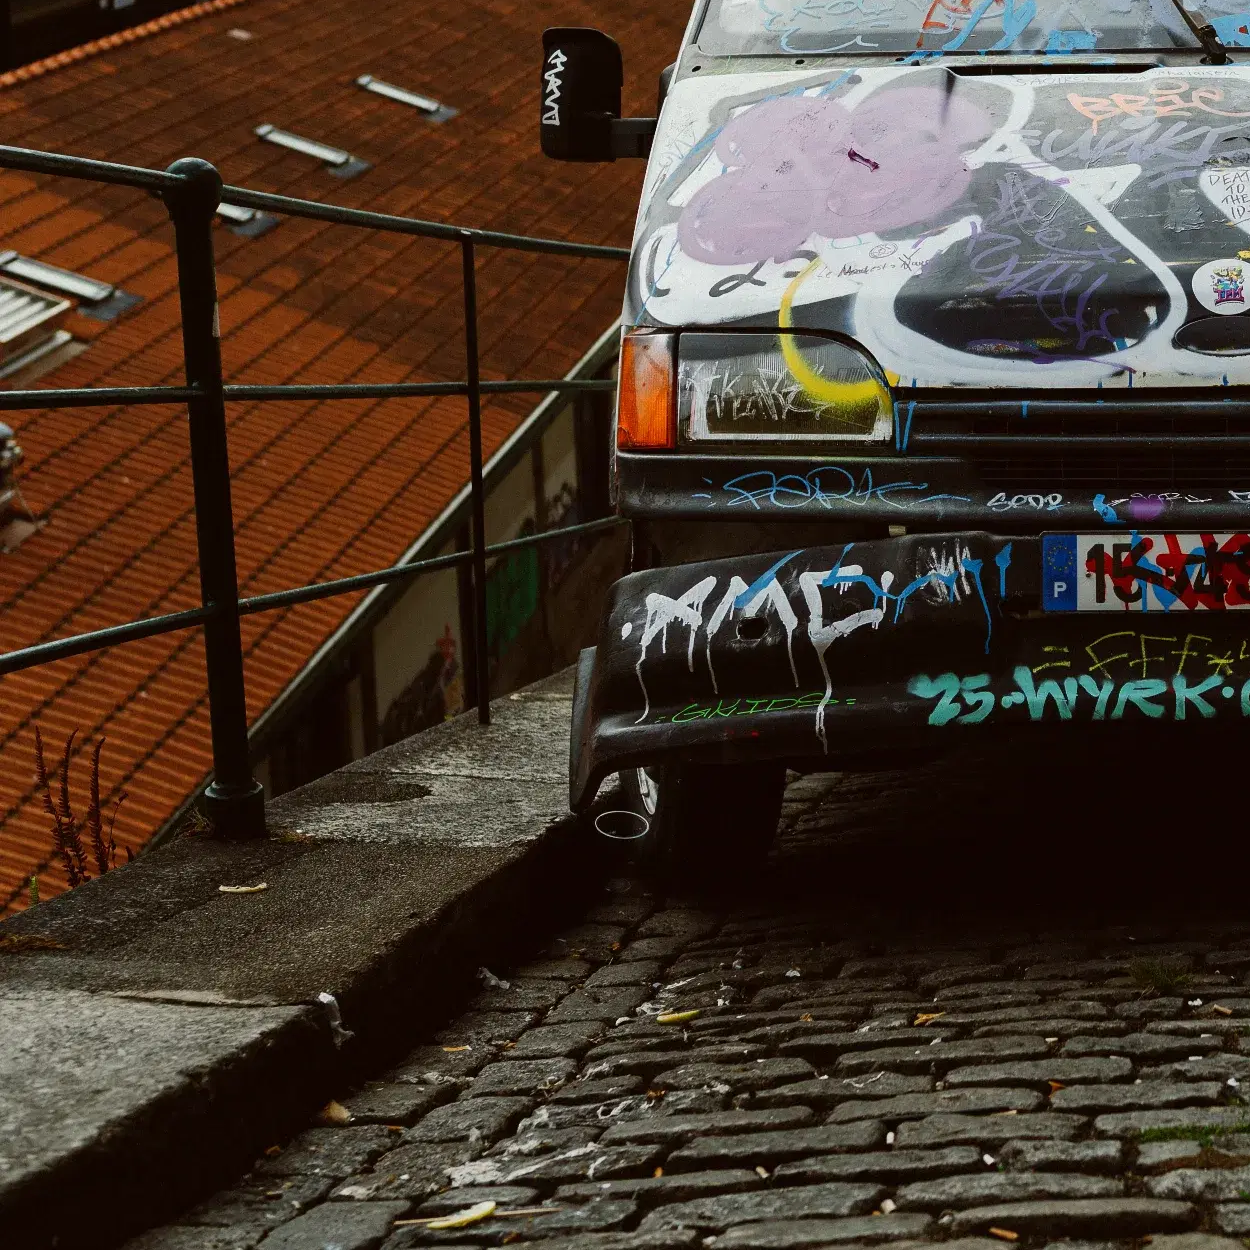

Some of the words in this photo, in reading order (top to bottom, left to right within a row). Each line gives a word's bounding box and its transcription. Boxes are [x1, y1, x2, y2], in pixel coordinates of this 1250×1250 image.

[1225, 184, 1246, 195] TO
[1221, 193, 1250, 205] THE
[1053, 581, 1067, 598] P
